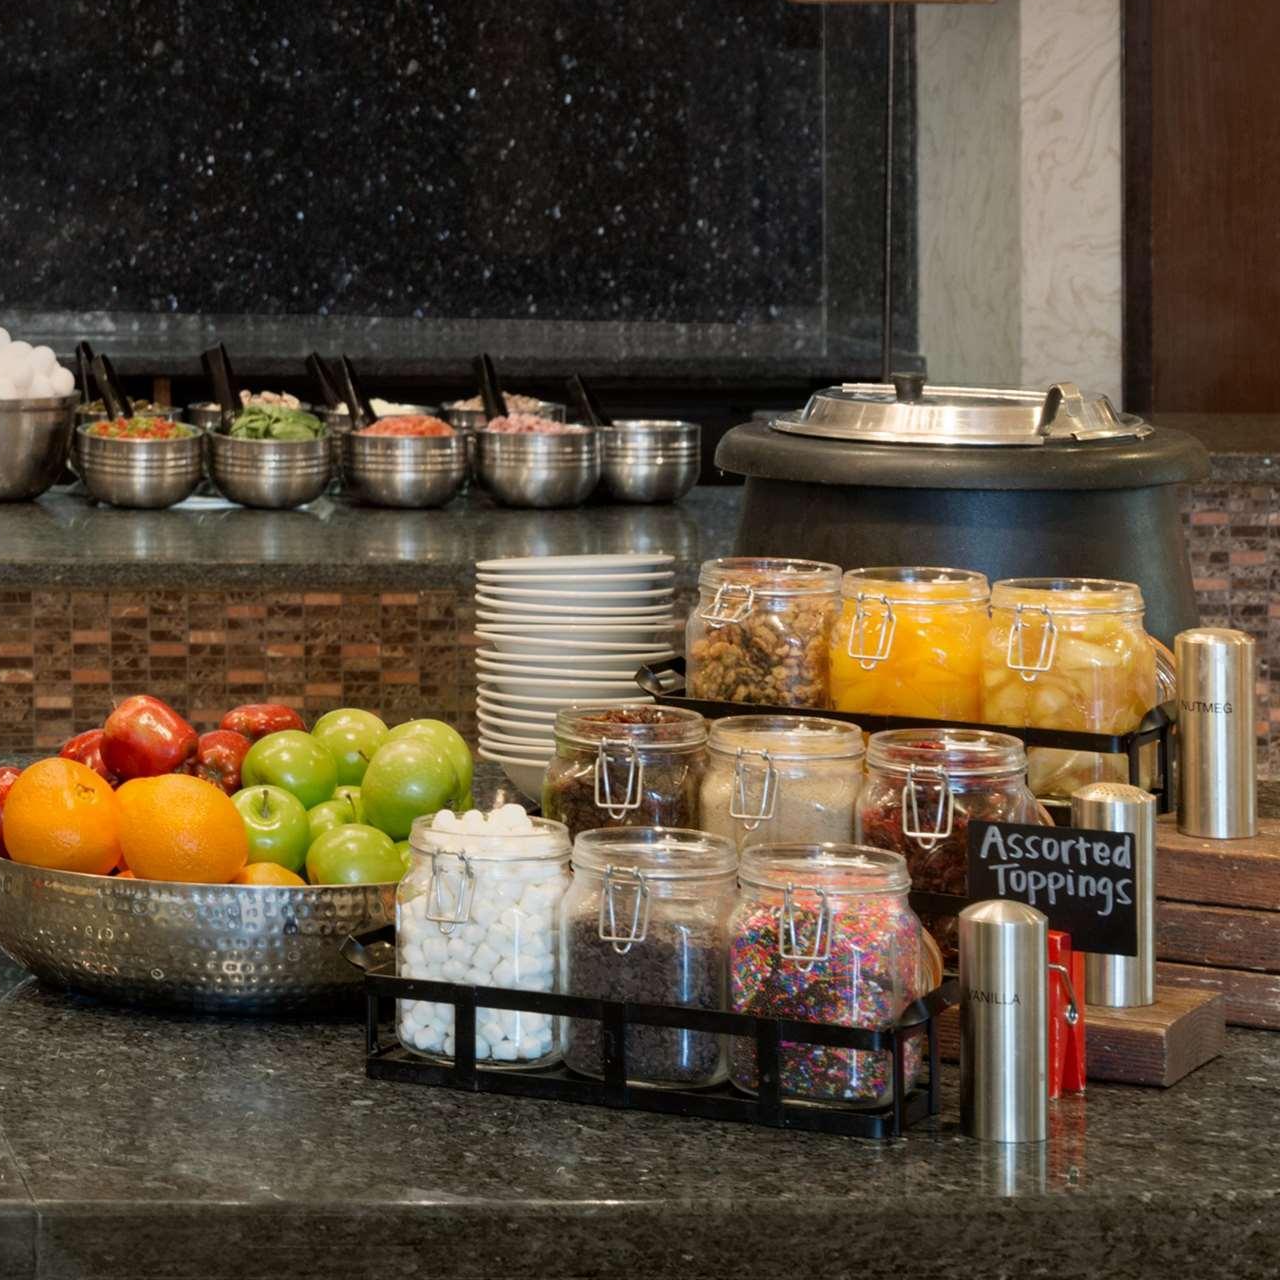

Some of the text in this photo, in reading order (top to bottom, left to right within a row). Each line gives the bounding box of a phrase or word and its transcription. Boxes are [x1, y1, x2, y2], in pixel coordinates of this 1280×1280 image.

[1181, 700, 1232, 714] NUTMEG
[979, 825, 1132, 869] Assorted
[989, 863, 1133, 916] Toppings
